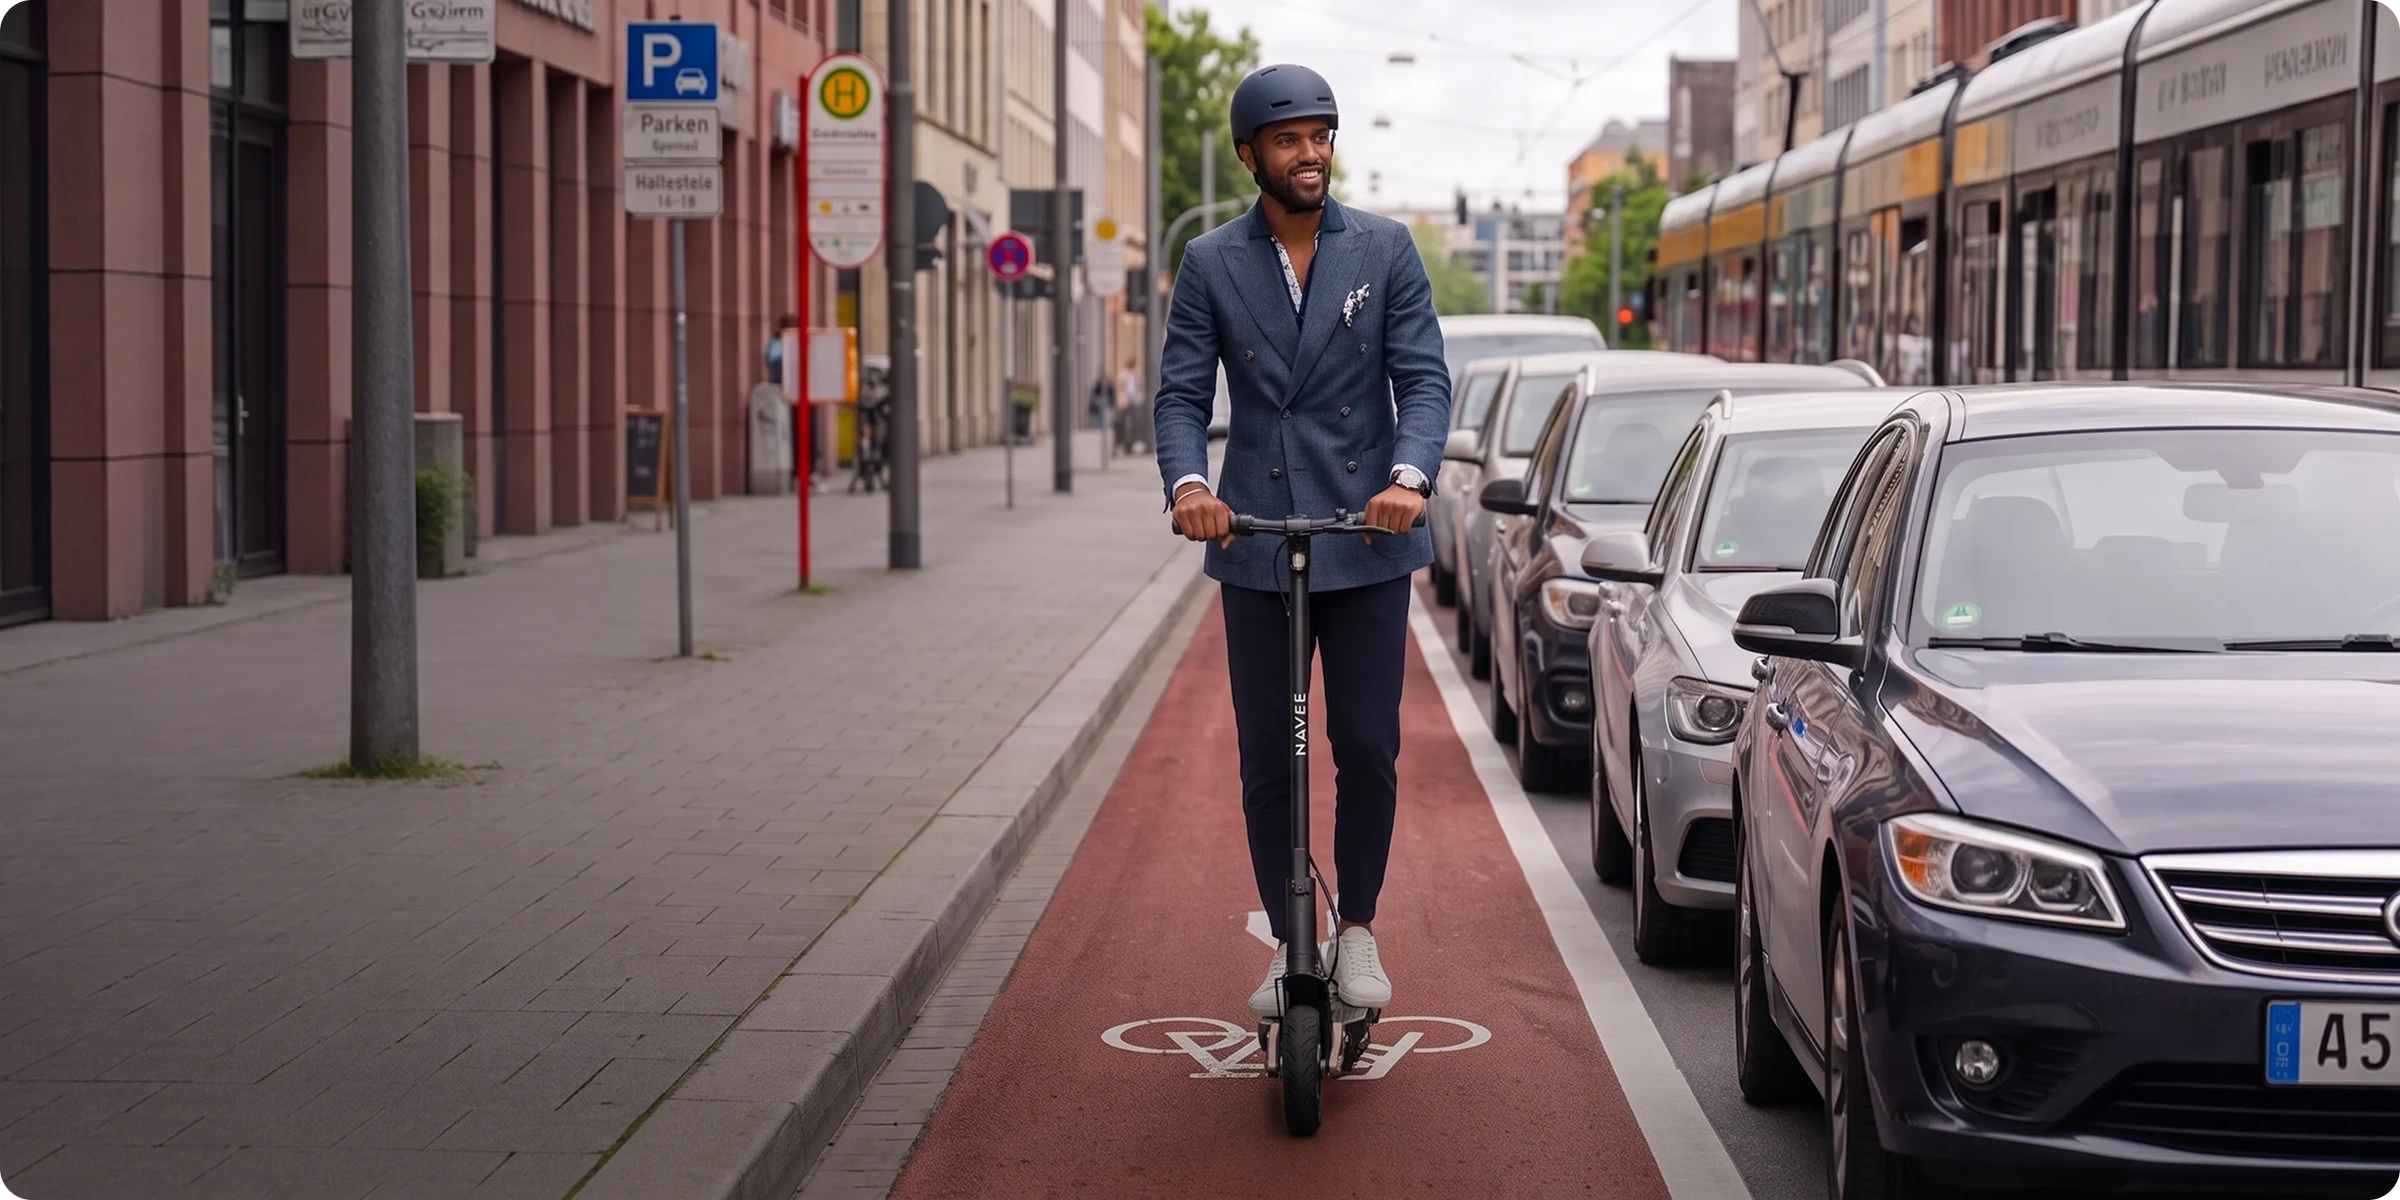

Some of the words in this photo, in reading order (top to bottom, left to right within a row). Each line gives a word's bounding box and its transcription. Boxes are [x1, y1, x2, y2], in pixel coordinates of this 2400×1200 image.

[643, 33, 682, 88] P
[834, 77, 857, 109] H
[640, 113, 709, 134] Parken
[635, 173, 713, 192] Haltestele
[1293, 693, 1306, 756] NAVEE
[2317, 1013, 2391, 1071] A5
